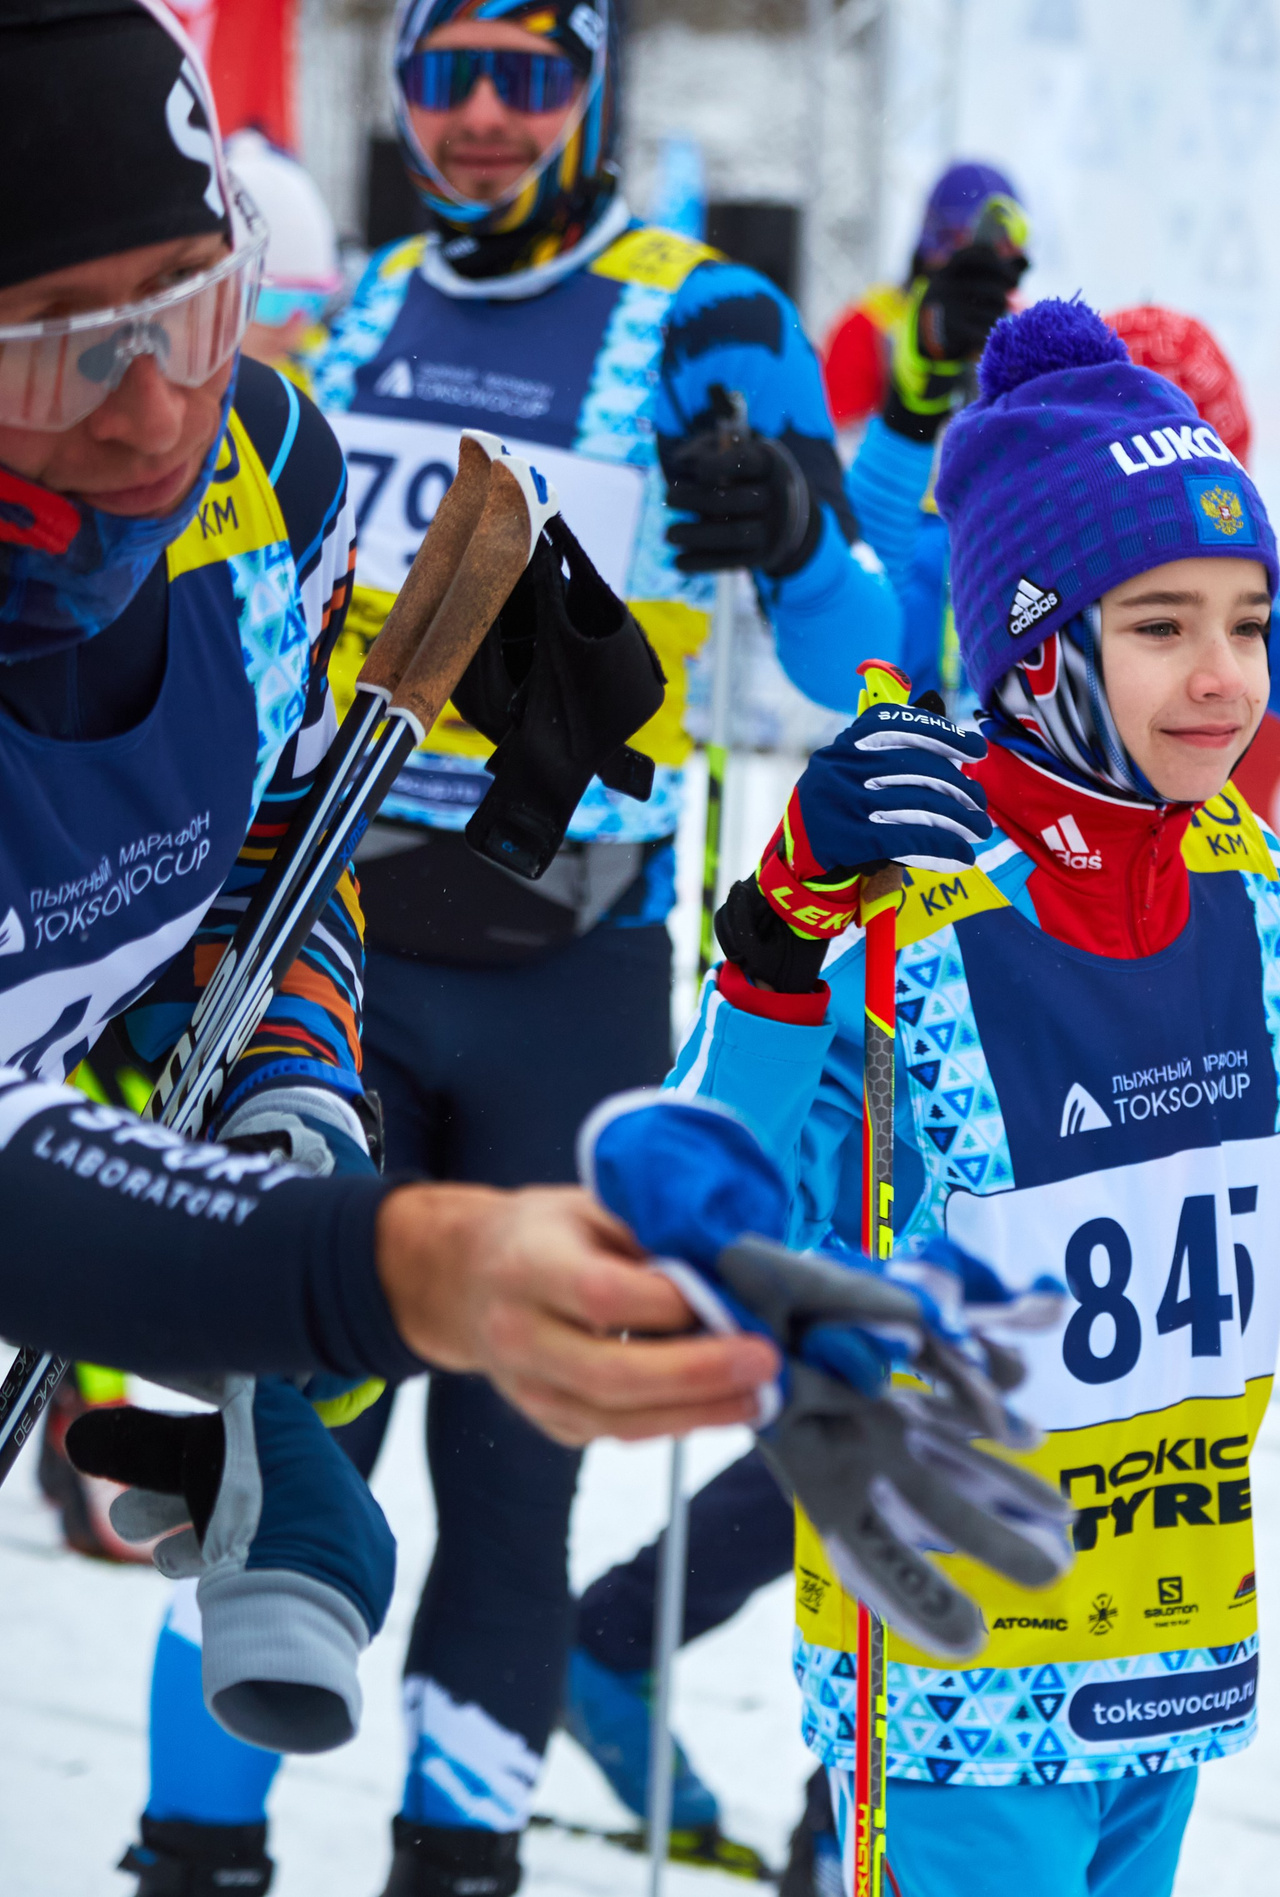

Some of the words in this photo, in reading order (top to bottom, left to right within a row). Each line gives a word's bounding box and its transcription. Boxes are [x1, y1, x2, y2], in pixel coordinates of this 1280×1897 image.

[1109, 425, 1250, 477] LUKO
[197, 496, 240, 541] KM
[1010, 592, 1058, 636] adidas
[119, 810, 211, 867] МАРАФОН
[1206, 833, 1249, 857] KM
[34, 838, 211, 950] TOKSOVOCUP
[920, 877, 969, 917] KM
[1112, 1057, 1193, 1094] ЛЫЖНЫЙ
[33, 1127, 259, 1226] LABORATORY
[992, 1617, 1068, 1632] ATOMIC
[1093, 1678, 1255, 1726] toksovocup.ru
